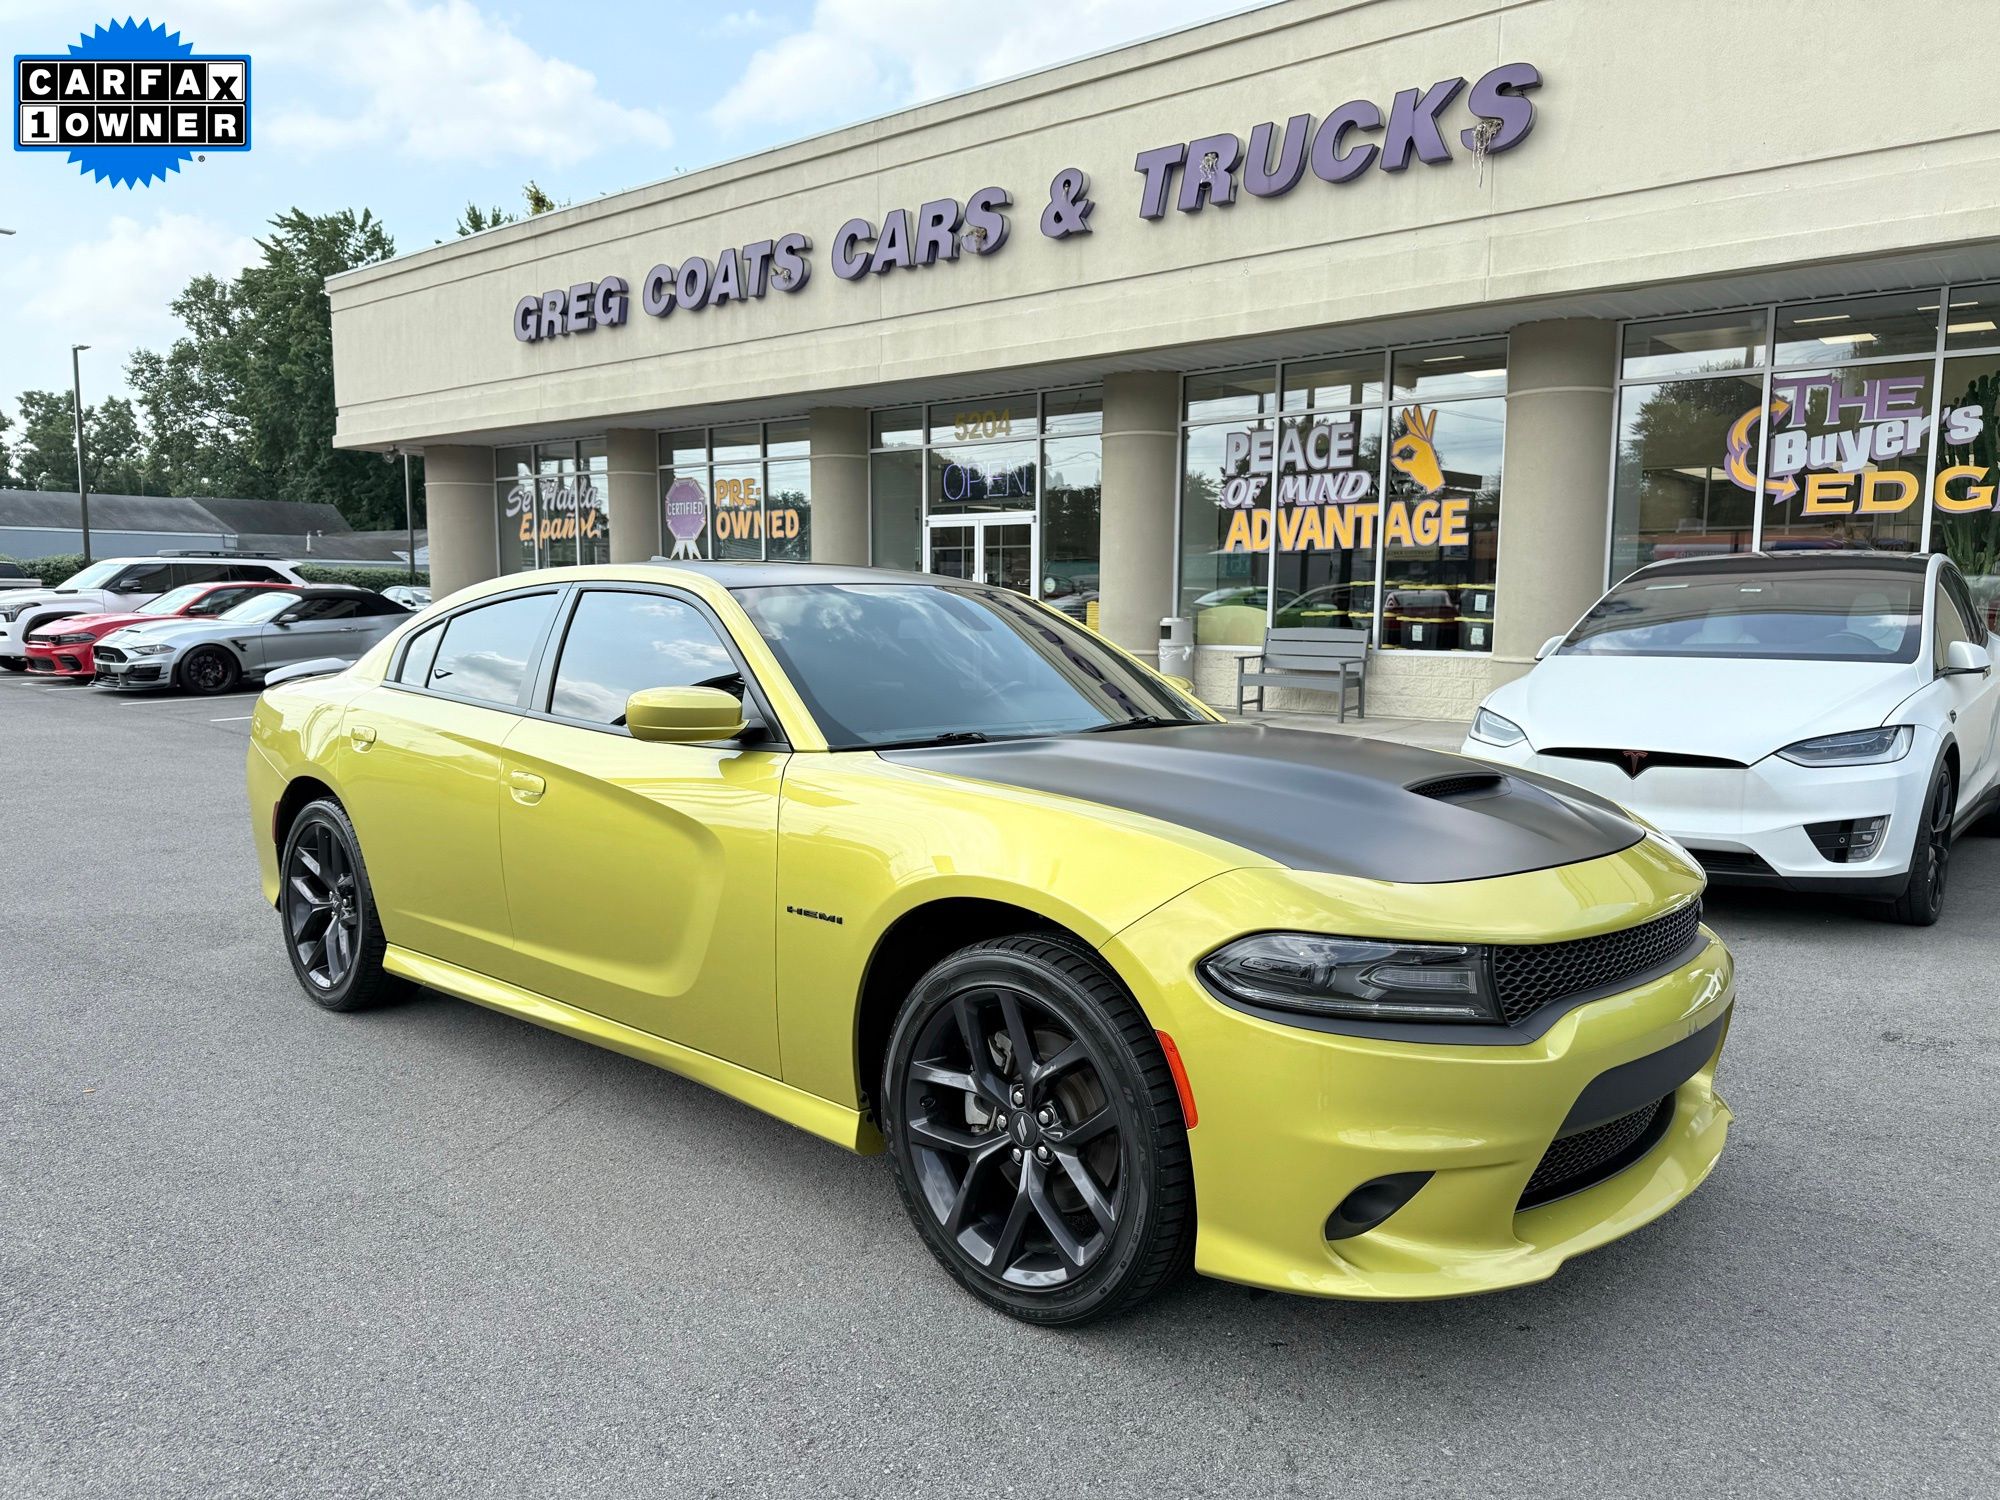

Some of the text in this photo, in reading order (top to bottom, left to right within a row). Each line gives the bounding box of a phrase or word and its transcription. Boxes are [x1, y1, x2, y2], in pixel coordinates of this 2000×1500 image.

[513, 62, 1544, 343] GREG COATS CARS & TRUCKS
[1773, 373, 1926, 429] THE
[954, 408, 1014, 441] 5204
[1769, 404, 1984, 477] Buyer's
[1225, 421, 1355, 477] PEACE
[715, 478, 762, 508] PRE-
[943, 456, 1027, 500] OPEN
[1220, 470, 1372, 509] OF MIND
[1800, 465, 2000, 517] EDG
[506, 485, 532, 517] Se
[667, 501, 704, 516] CERTIFIED
[716, 508, 800, 541] OWNED
[1224, 498, 1470, 552] ADVANTAGE
[786, 905, 843, 925] HEMI
